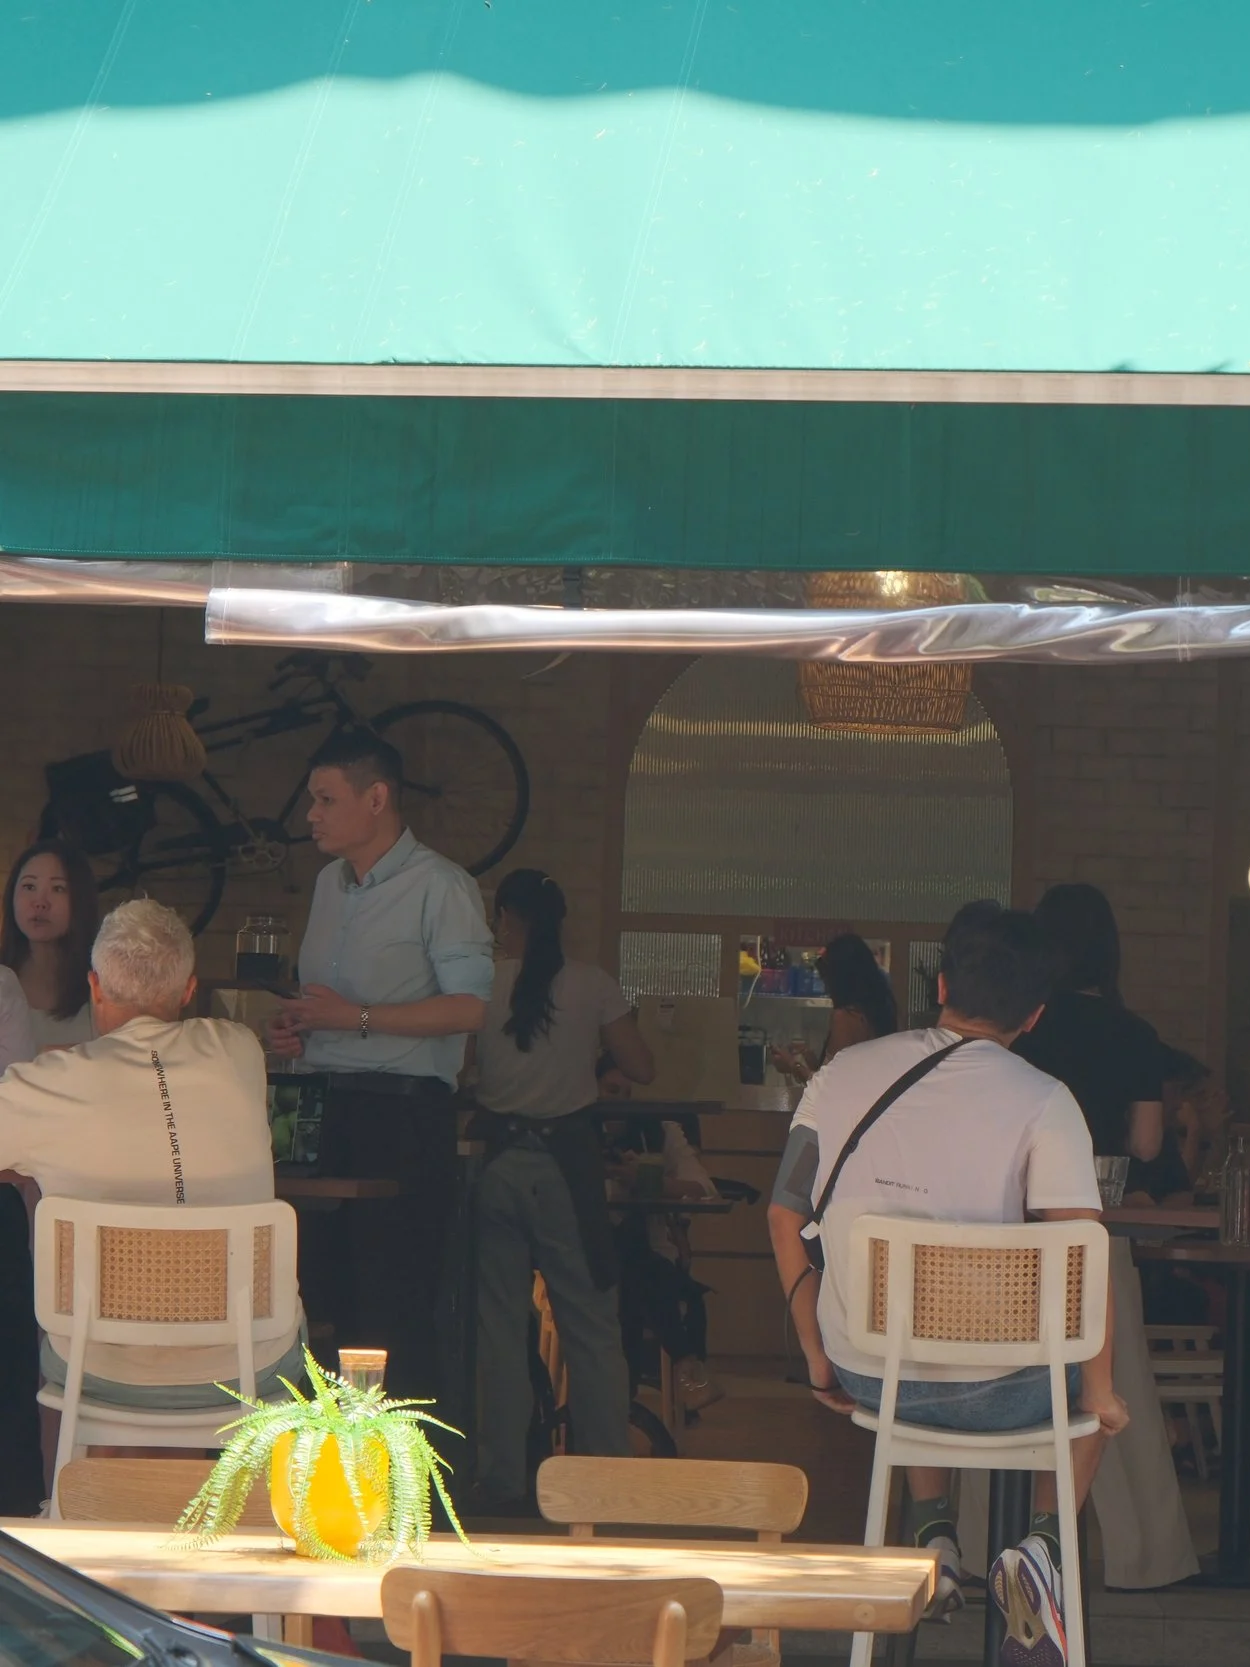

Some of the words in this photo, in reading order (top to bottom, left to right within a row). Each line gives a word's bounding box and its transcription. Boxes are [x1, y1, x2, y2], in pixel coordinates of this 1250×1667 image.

[162, 1101, 172, 1111] IN
[165, 1113, 176, 1129] THE
[169, 1131, 181, 1156] AAPE
[172, 1158, 186, 1205] UNIVERSE
